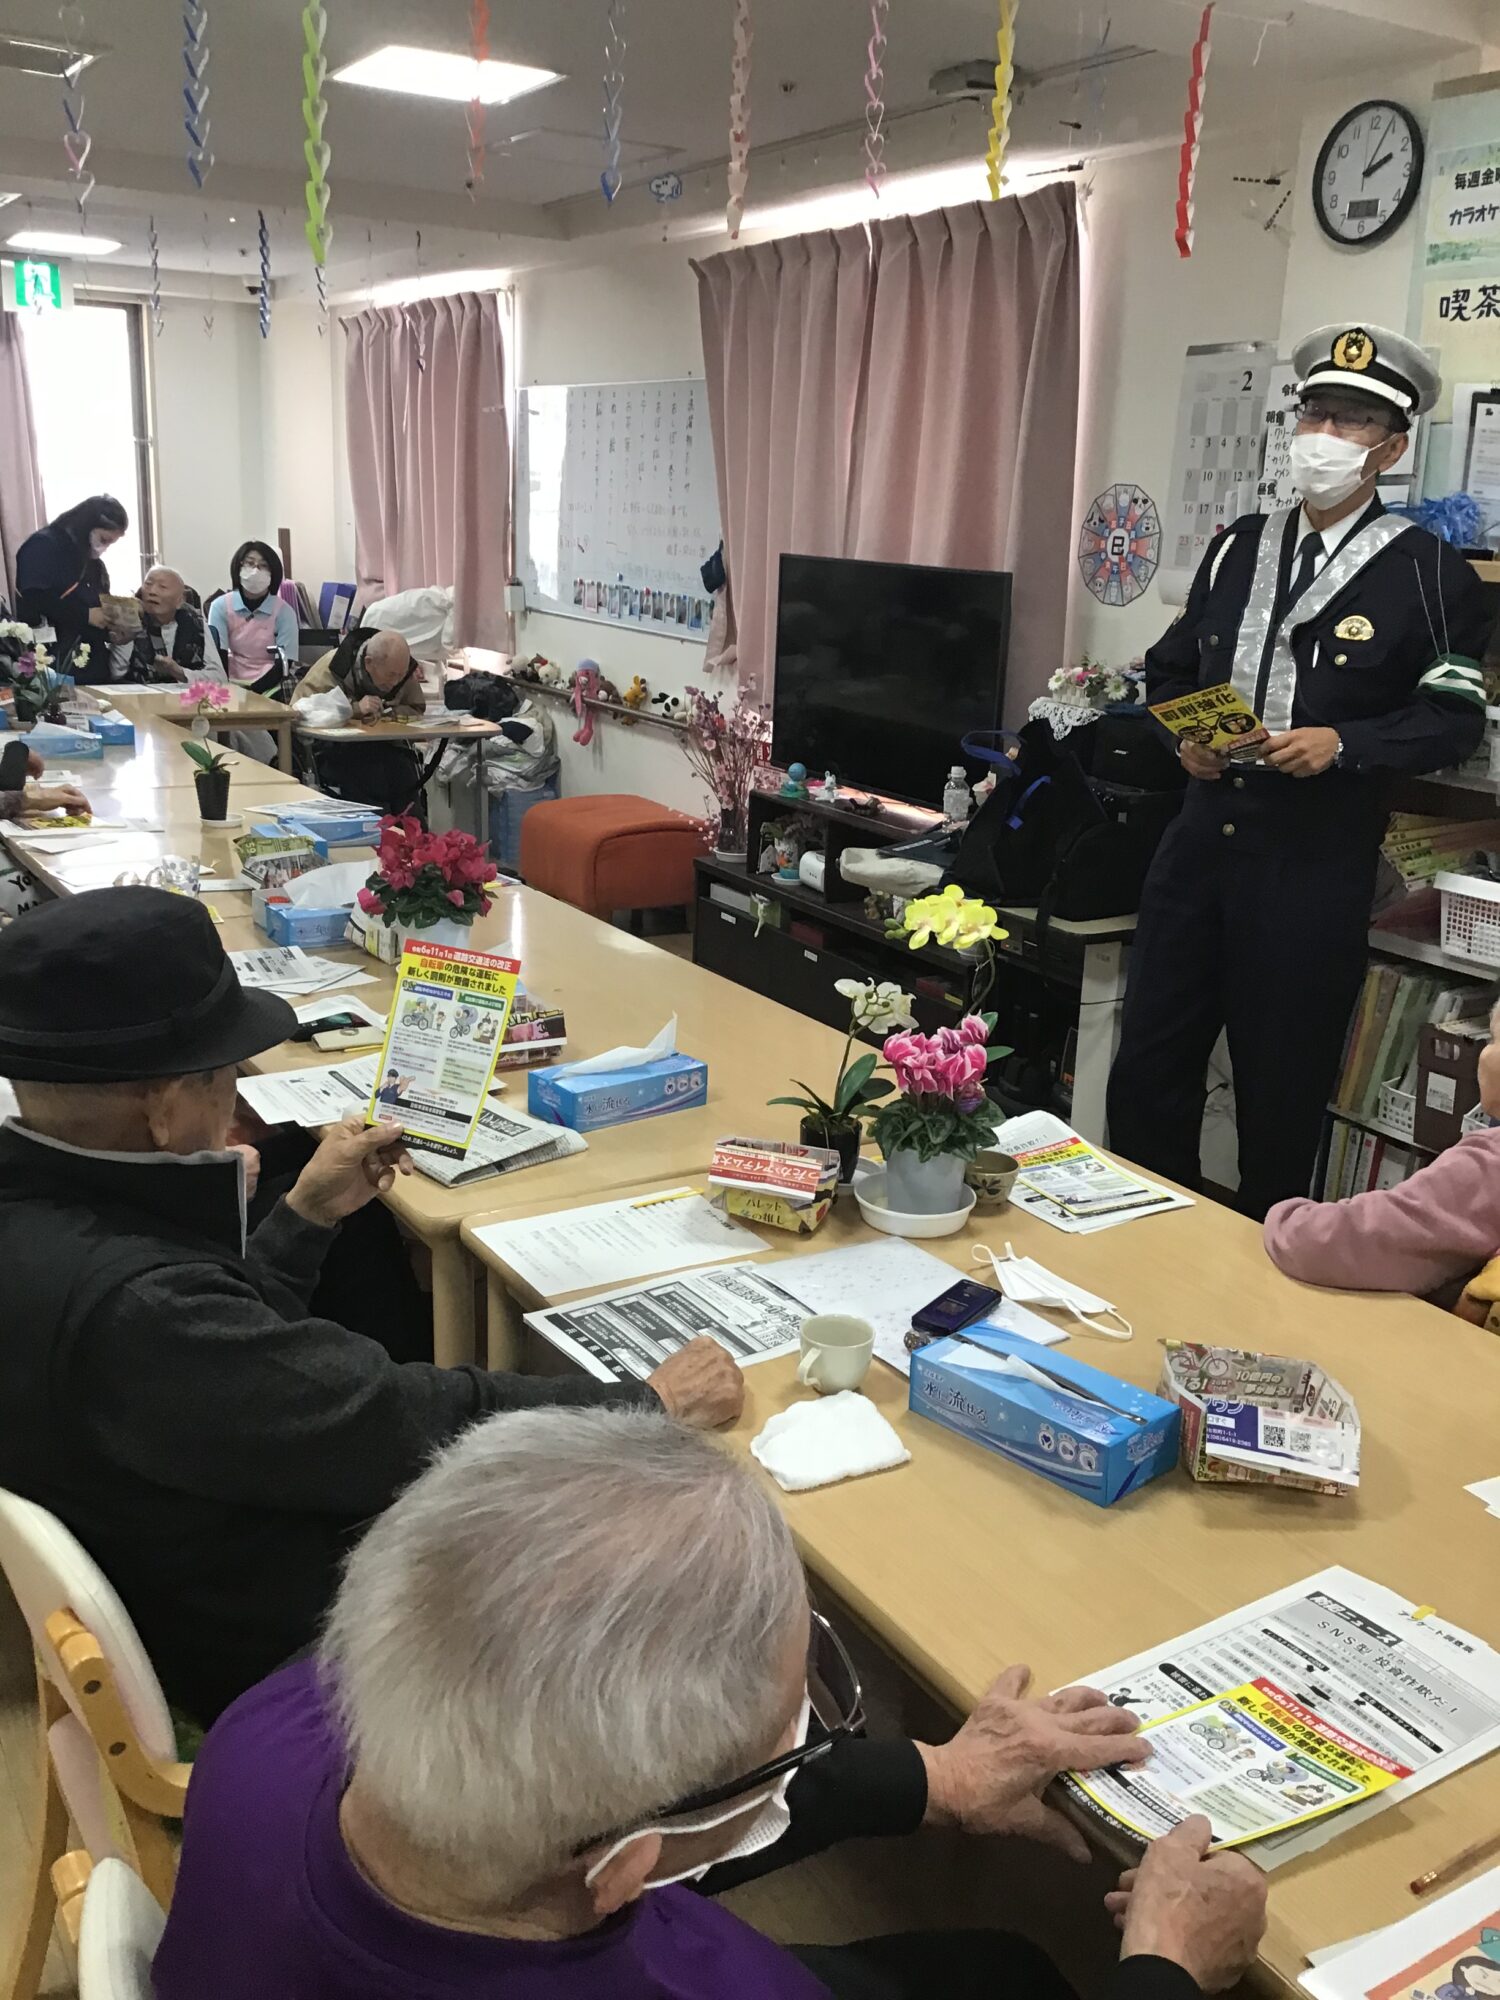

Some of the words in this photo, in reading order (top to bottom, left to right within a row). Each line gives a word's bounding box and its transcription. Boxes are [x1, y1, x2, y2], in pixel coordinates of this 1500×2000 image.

[1370, 115, 1382, 130] 12
[1353, 125, 1361, 140] 11
[1337, 144, 1349, 159] 10
[1400, 136, 1410, 152] 2
[1328, 170, 1336, 186] 9
[1402, 162, 1412, 178] 3
[1330, 194, 1338, 209] 8
[1392, 187, 1401, 203] 4
[1378, 209, 1387, 223] 5
[1449, 203, 1500, 226] カラオケ
[1357, 220, 1365, 234] 6
[1439, 284, 1500, 322] 喫茶
[1241, 370, 1253, 391] 2
[1190, 438, 1196, 449] 2
[1205, 437, 1211, 448] 3
[1220, 437, 1226, 448] 4
[1235, 437, 1241, 448] 5
[1250, 437, 1256, 447] 6
[1203, 469, 1212, 481] 10
[1233, 469, 1243, 482] 12
[1183, 503, 1194, 514] 16
[1199, 503, 1209, 514] 17
[1214, 503, 1224, 515] 18
[1179, 535, 1189, 546] 23
[1194, 536, 1205, 547] 24
[1159, 692, 1237, 722] 罰則強化
[420, 958, 500, 982] 自転車の危険な運転に
[407, 966, 507, 994] 新しく罰則が整備されました
[1237, 1696, 1371, 1783] 新しく罰則が整備されました
[1261, 1701, 1370, 1770] 自転車の危険な運転に
